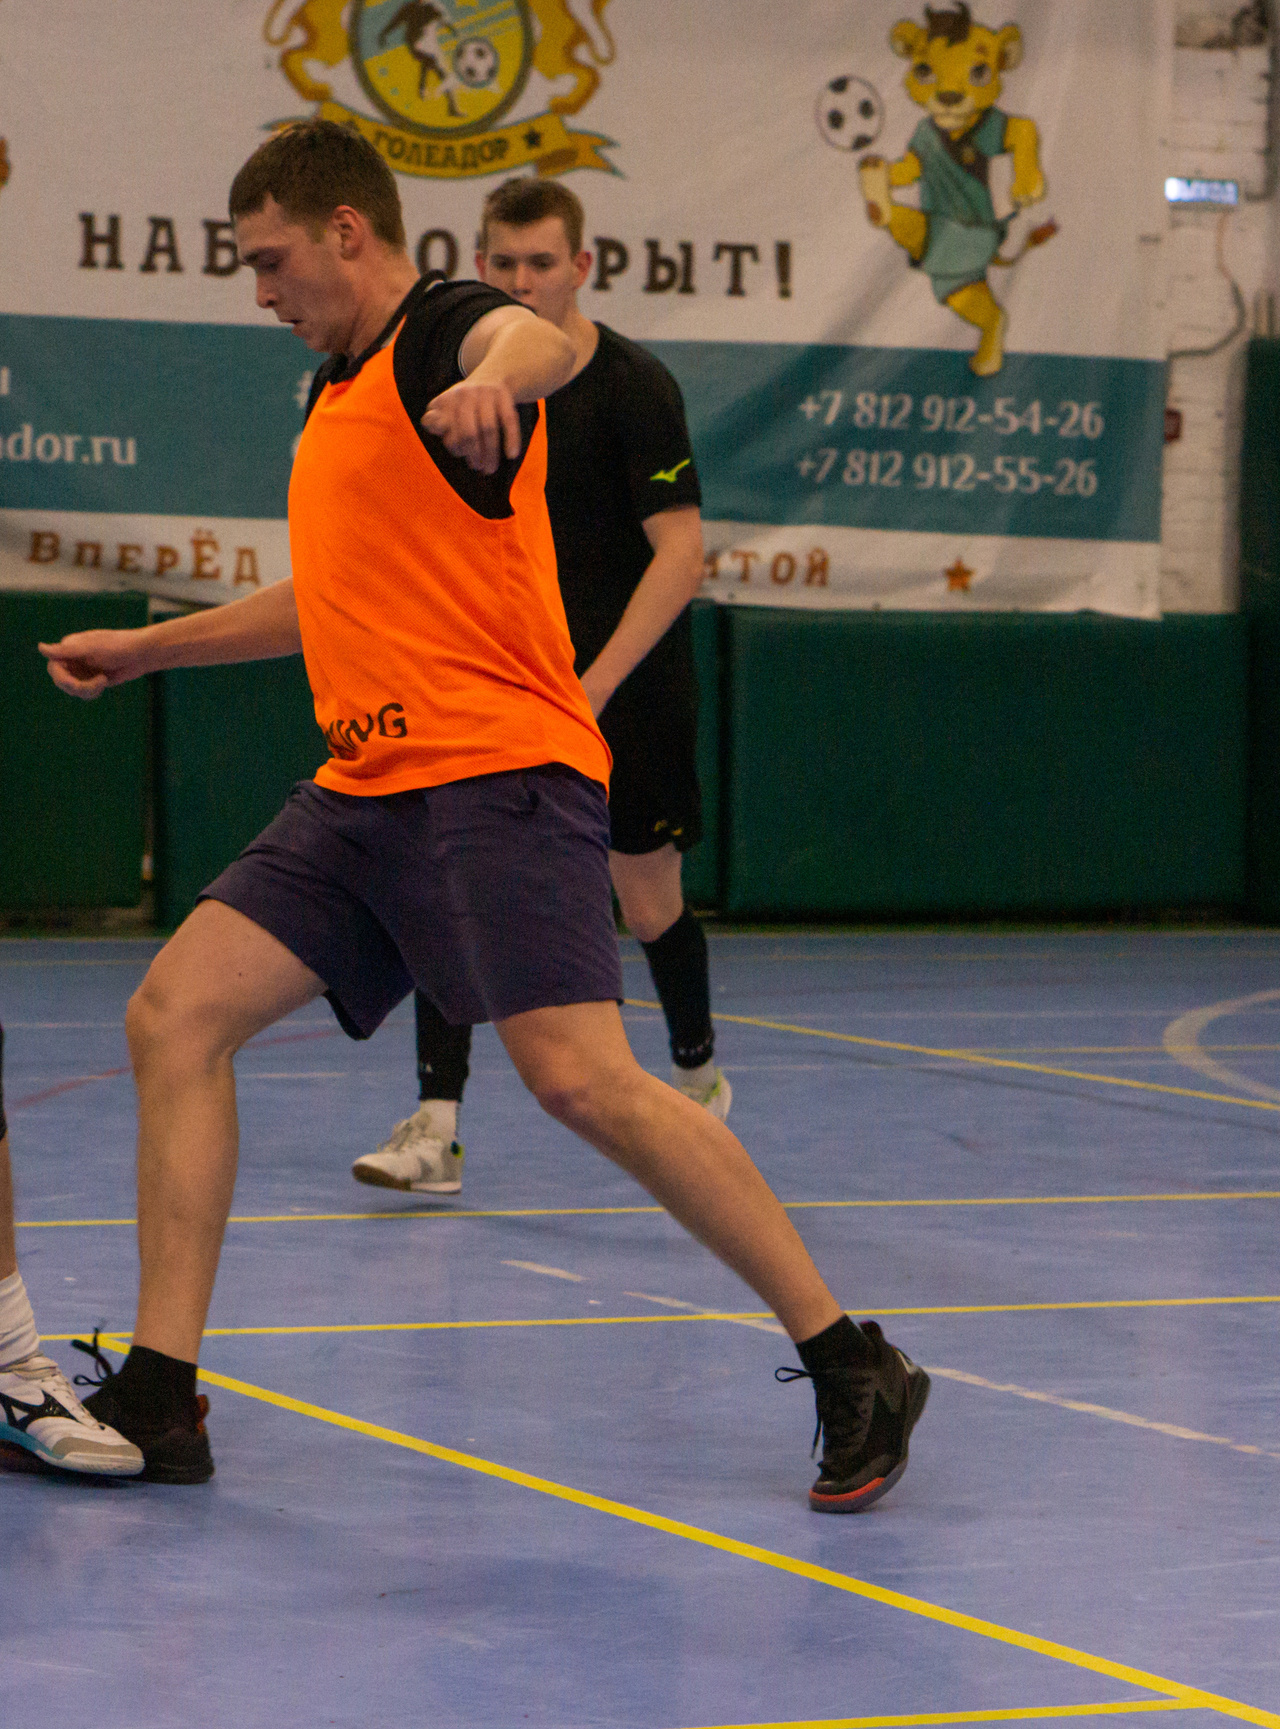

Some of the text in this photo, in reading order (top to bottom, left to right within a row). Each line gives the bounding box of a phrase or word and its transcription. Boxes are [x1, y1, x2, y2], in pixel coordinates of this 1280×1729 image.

[374, 130, 509, 169] ГОЛЕАДОР
[79, 212, 793, 299] НАБ ОРЫТ!
[799, 390, 1105, 439] +7 812 912-54-26
[798, 449, 1098, 497] +7 812 912-55-26
